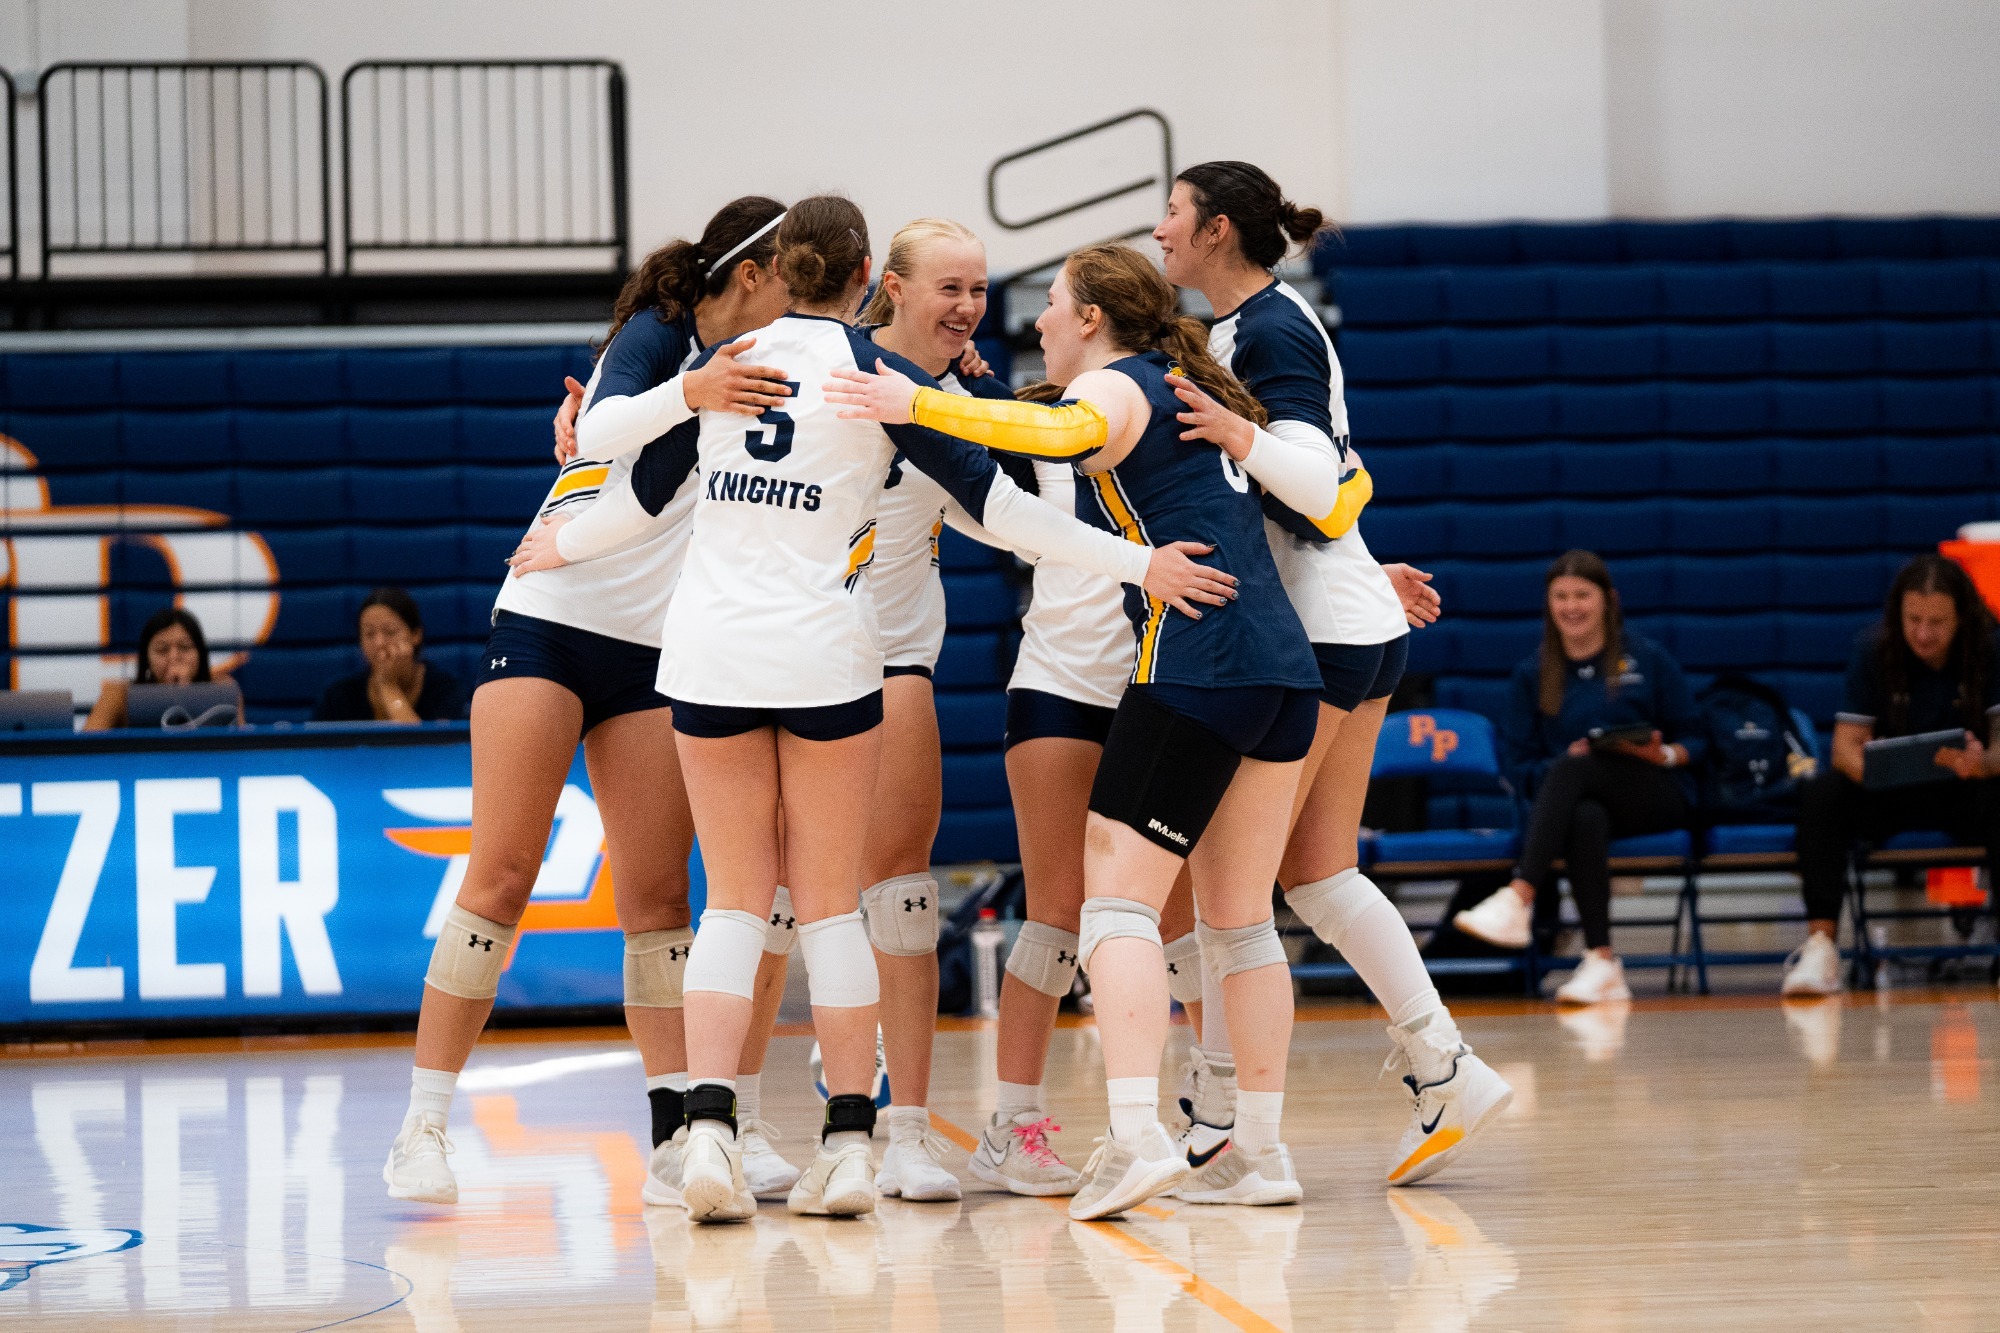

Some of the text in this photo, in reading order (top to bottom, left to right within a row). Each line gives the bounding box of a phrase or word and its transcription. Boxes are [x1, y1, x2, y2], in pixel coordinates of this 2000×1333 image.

[745, 378, 801, 463] 5
[706, 470, 823, 512] KNIGHTS
[0, 775, 344, 1004] ZER
